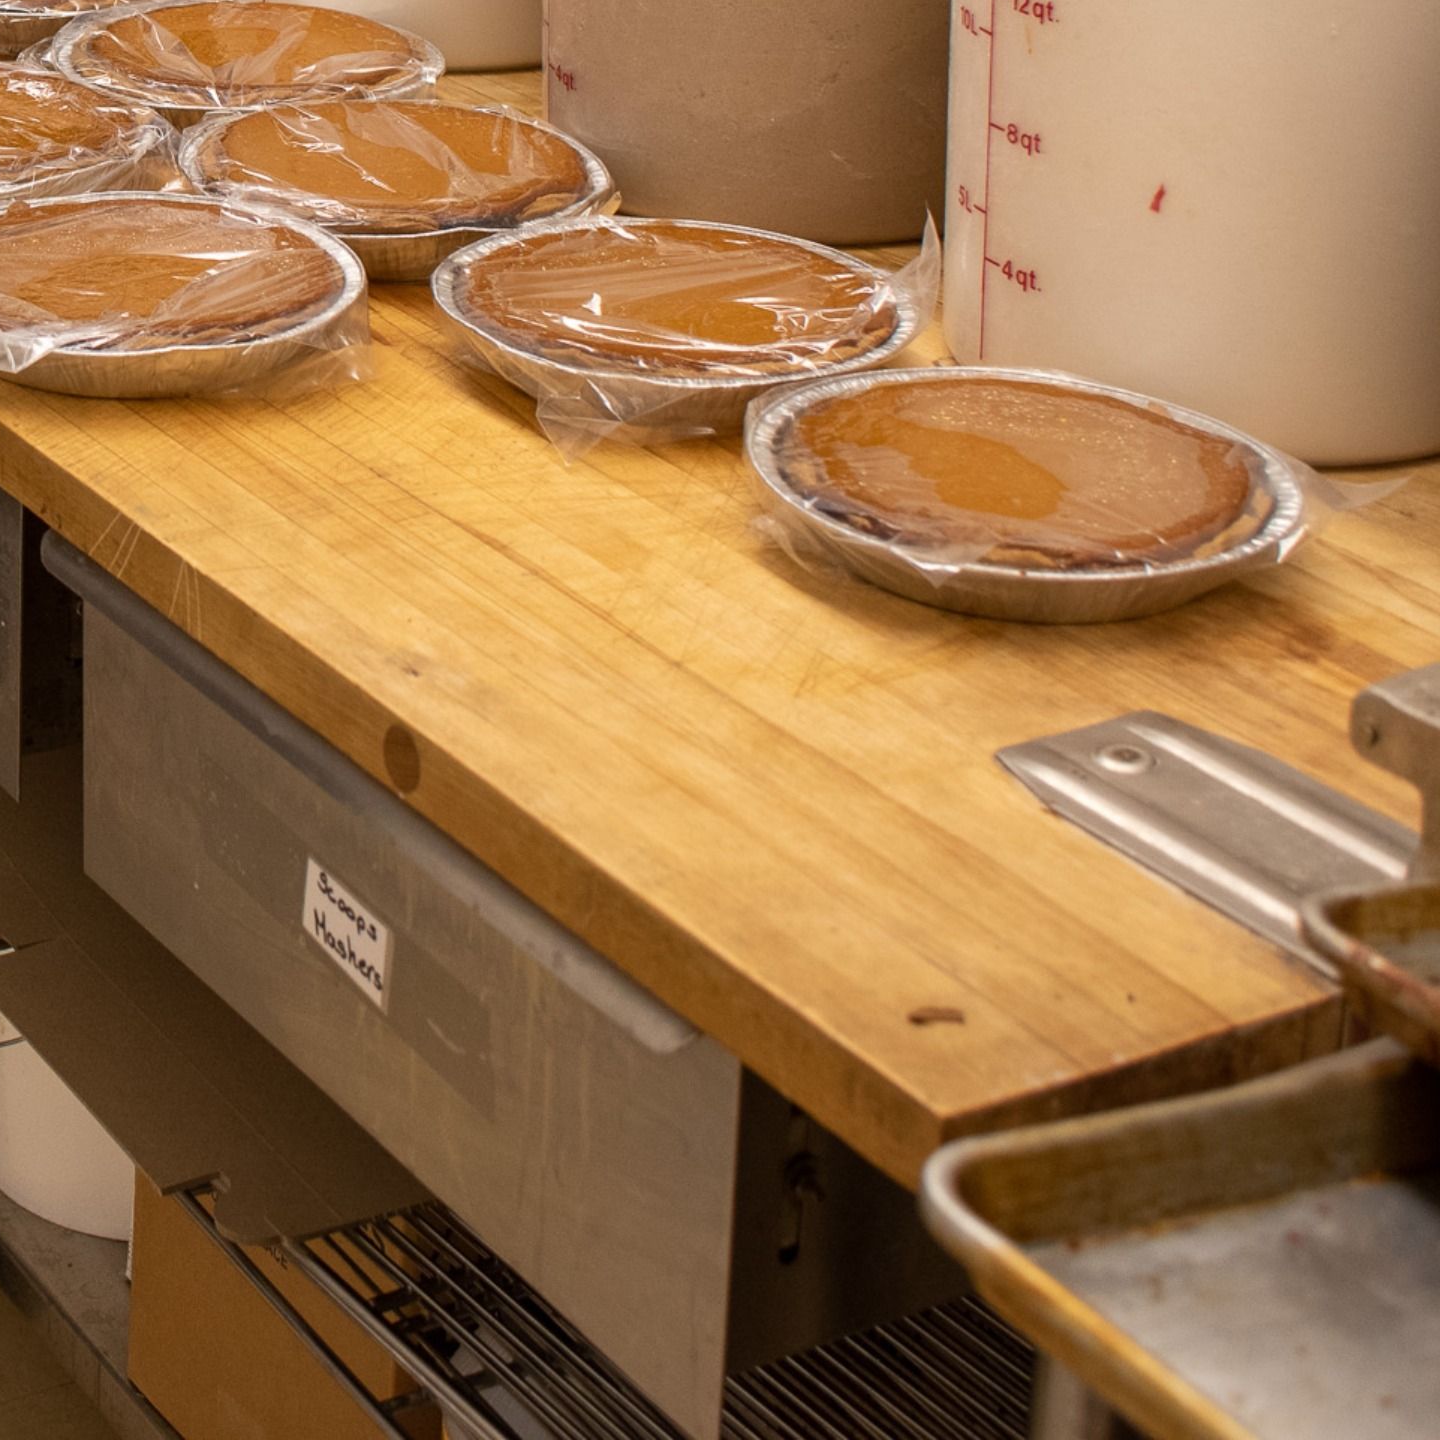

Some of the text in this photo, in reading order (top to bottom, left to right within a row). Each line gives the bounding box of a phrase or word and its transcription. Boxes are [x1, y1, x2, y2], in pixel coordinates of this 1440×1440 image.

[960, 6, 978, 36] 10L
[958, 185, 973, 214] 5L
[317, 871, 377, 942] Scoops
